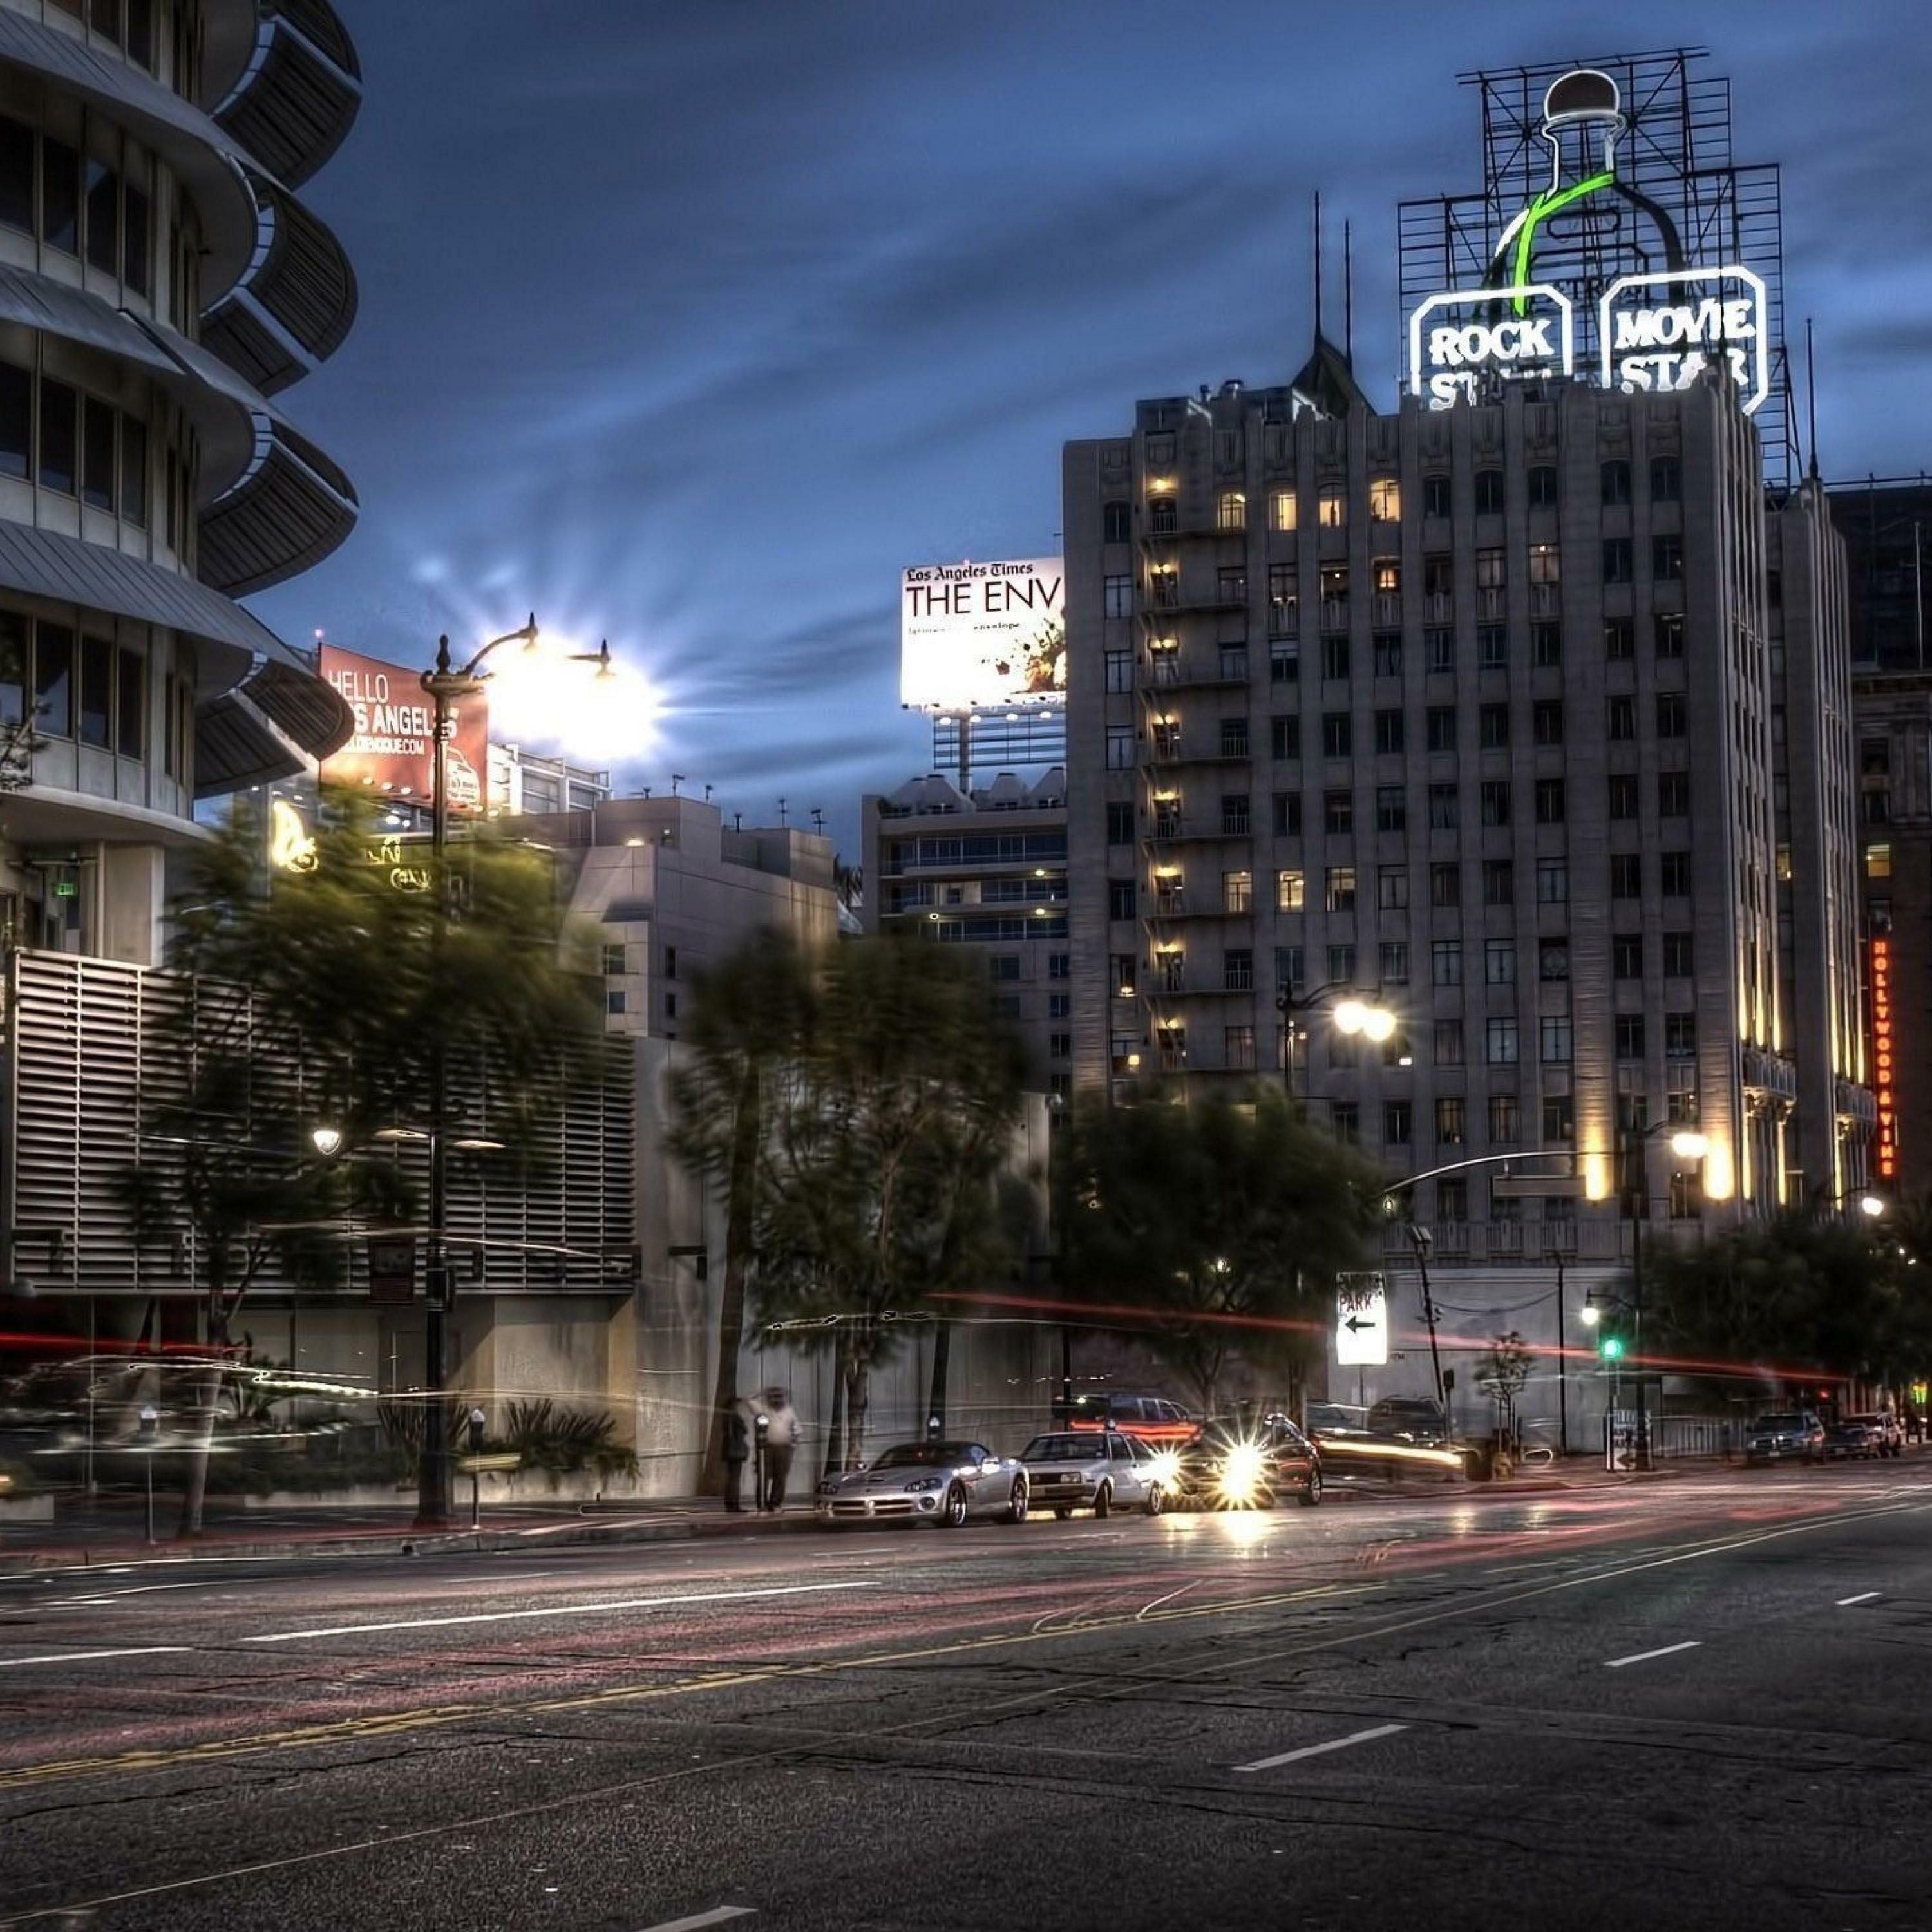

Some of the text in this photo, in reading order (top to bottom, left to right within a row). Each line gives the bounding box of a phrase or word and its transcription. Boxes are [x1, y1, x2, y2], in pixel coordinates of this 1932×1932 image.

[1429, 320, 1555, 366] ROCK
[1615, 298, 1756, 349] MOVIE
[907, 563, 1033, 582] Los Angeles Times
[905, 576, 1062, 617] THE ENV
[328, 670, 388, 704] HELLO
[1874, 942, 1891, 1084] HOLLYWOOD
[1880, 1112, 1894, 1175] VINE
